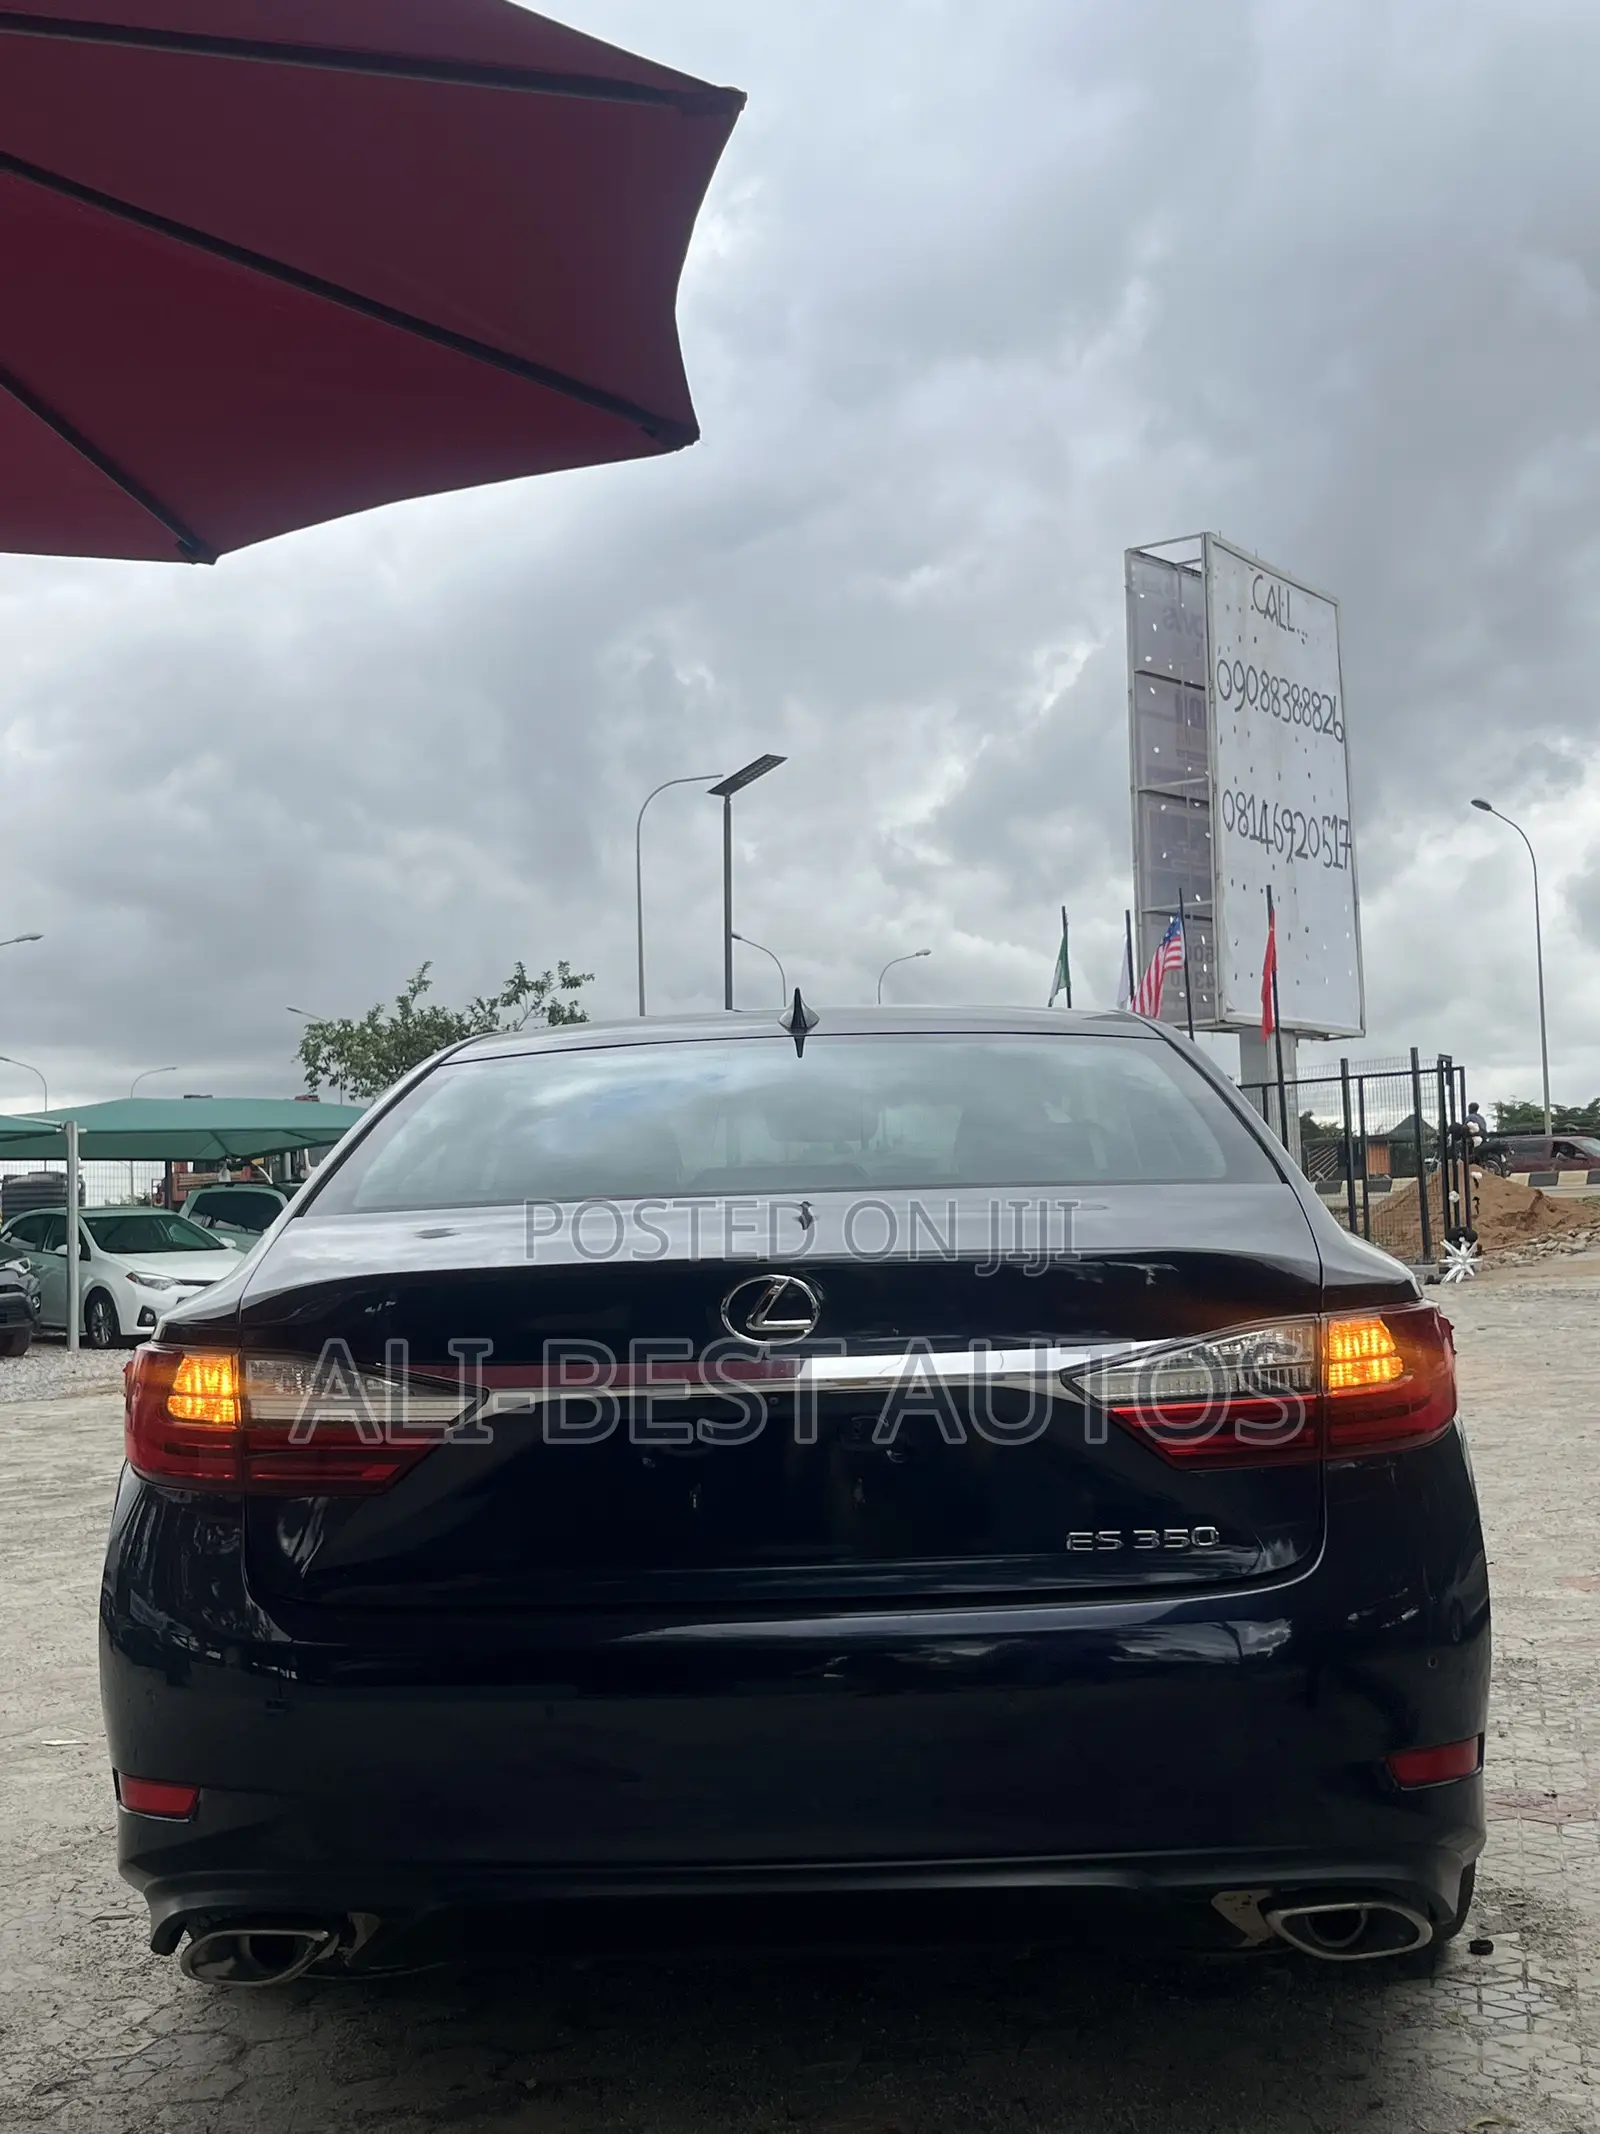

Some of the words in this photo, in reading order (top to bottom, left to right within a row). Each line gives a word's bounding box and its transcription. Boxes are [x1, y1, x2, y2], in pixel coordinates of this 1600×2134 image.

[1222, 788, 1351, 870] 08146920517
[1066, 1531, 1124, 1551] ES
[1132, 1526, 1220, 1549] 350
